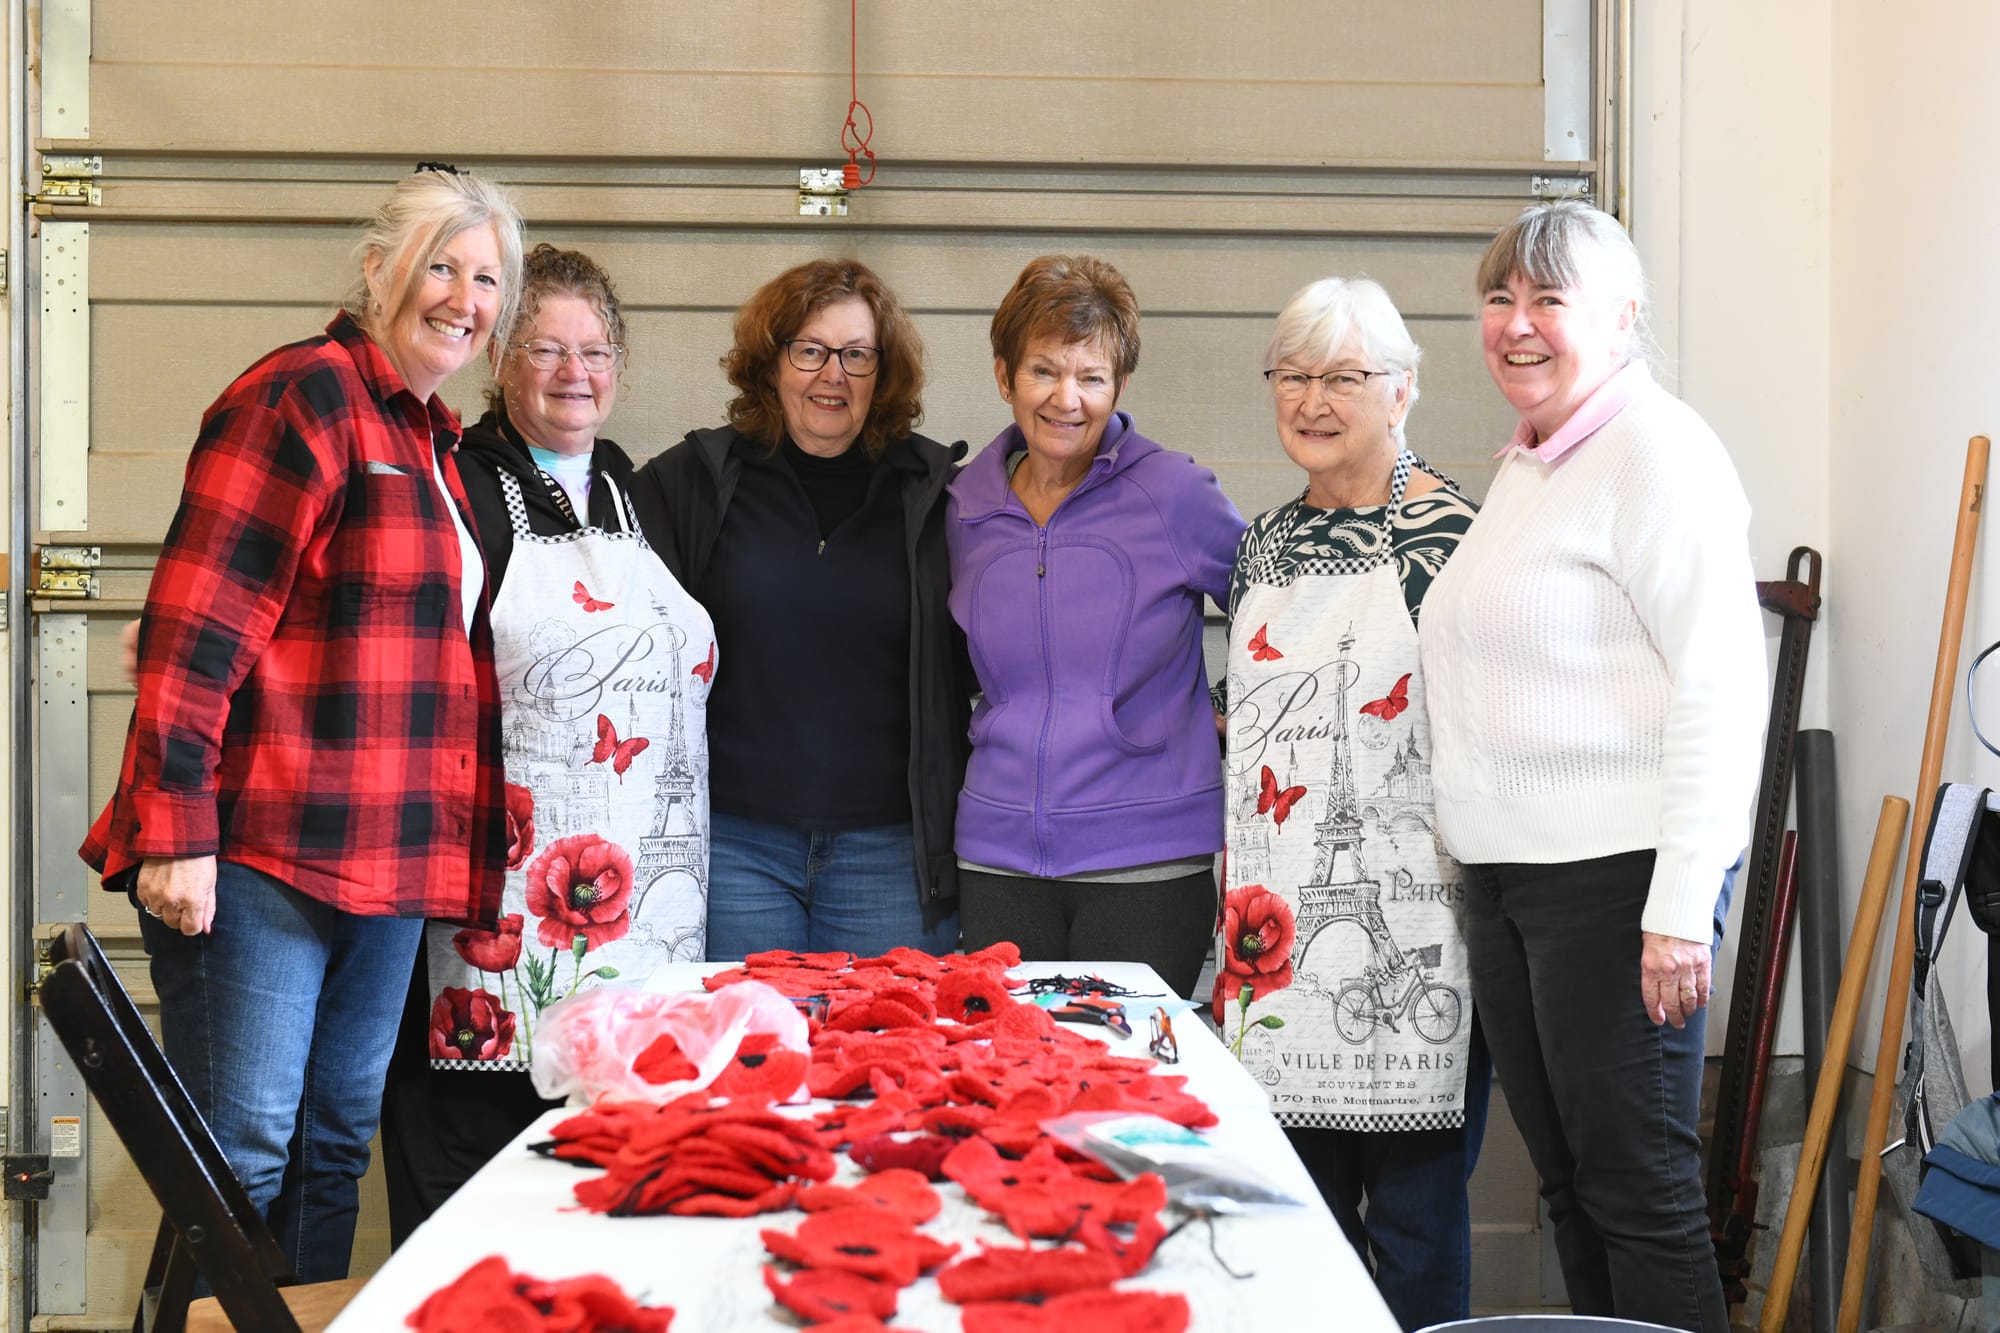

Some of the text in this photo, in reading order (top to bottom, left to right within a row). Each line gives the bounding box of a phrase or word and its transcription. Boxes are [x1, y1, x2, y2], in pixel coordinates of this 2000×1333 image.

[523, 622, 687, 723] Paris
[1227, 659, 1360, 776] Paris
[1281, 1052, 1454, 1070] VILLE DE PARIS
[1312, 1095, 1338, 1104] Rue
[1429, 1093, 1456, 1104] 170
